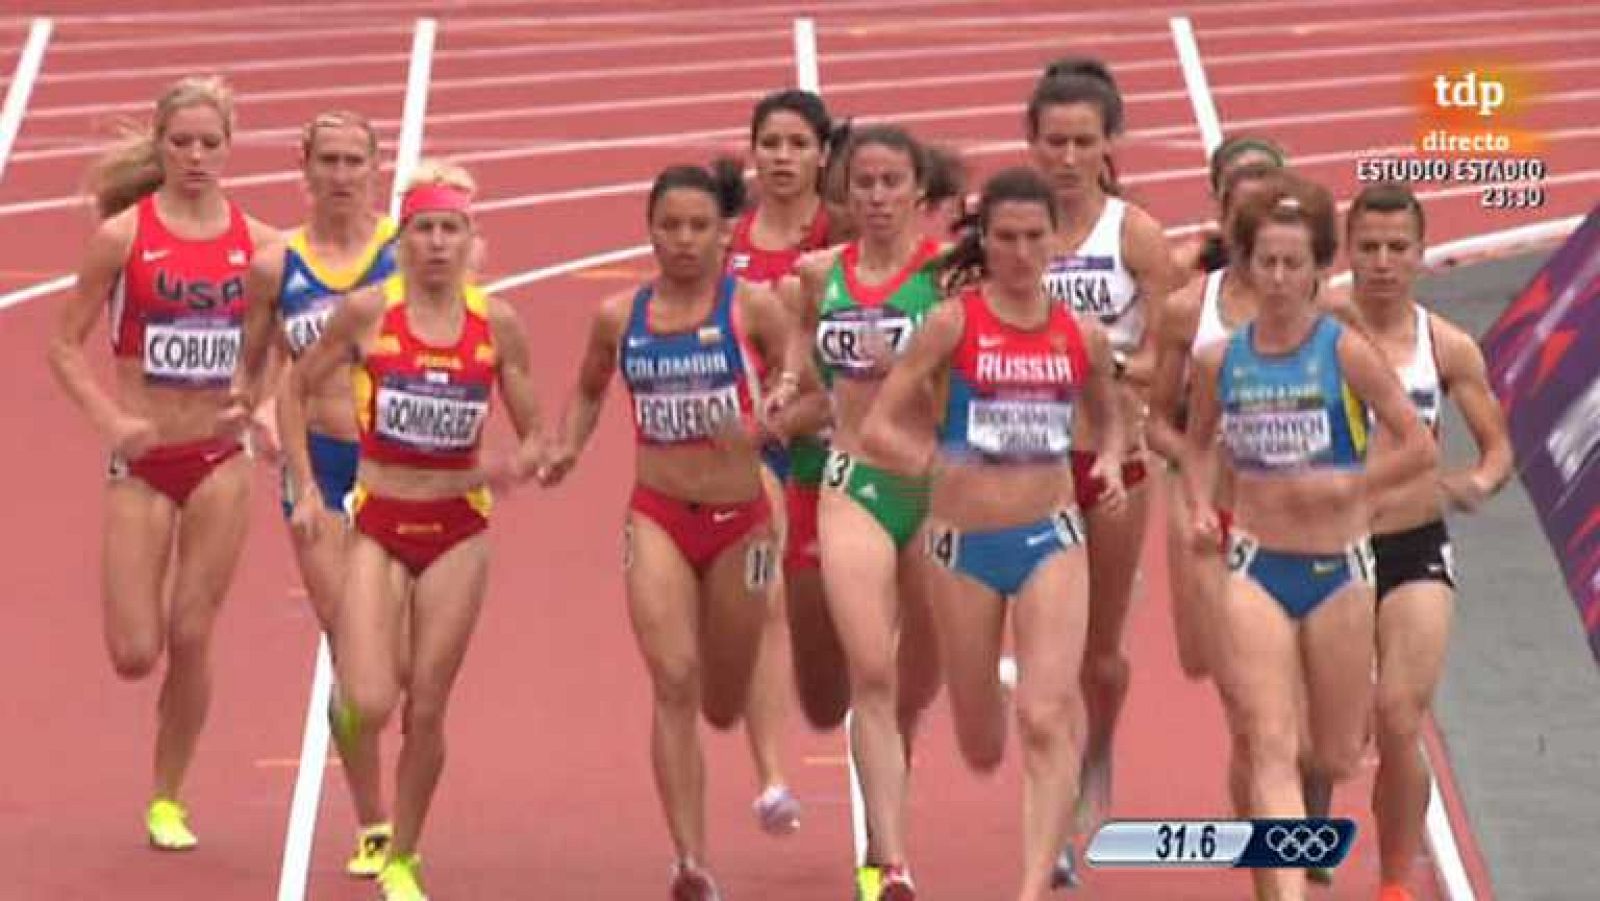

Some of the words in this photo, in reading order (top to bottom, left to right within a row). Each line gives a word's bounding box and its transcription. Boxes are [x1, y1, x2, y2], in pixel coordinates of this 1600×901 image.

[157, 268, 242, 309] USA
[627, 352, 728, 377] COLOMBIA
[977, 352, 1072, 383] RUSSIA
